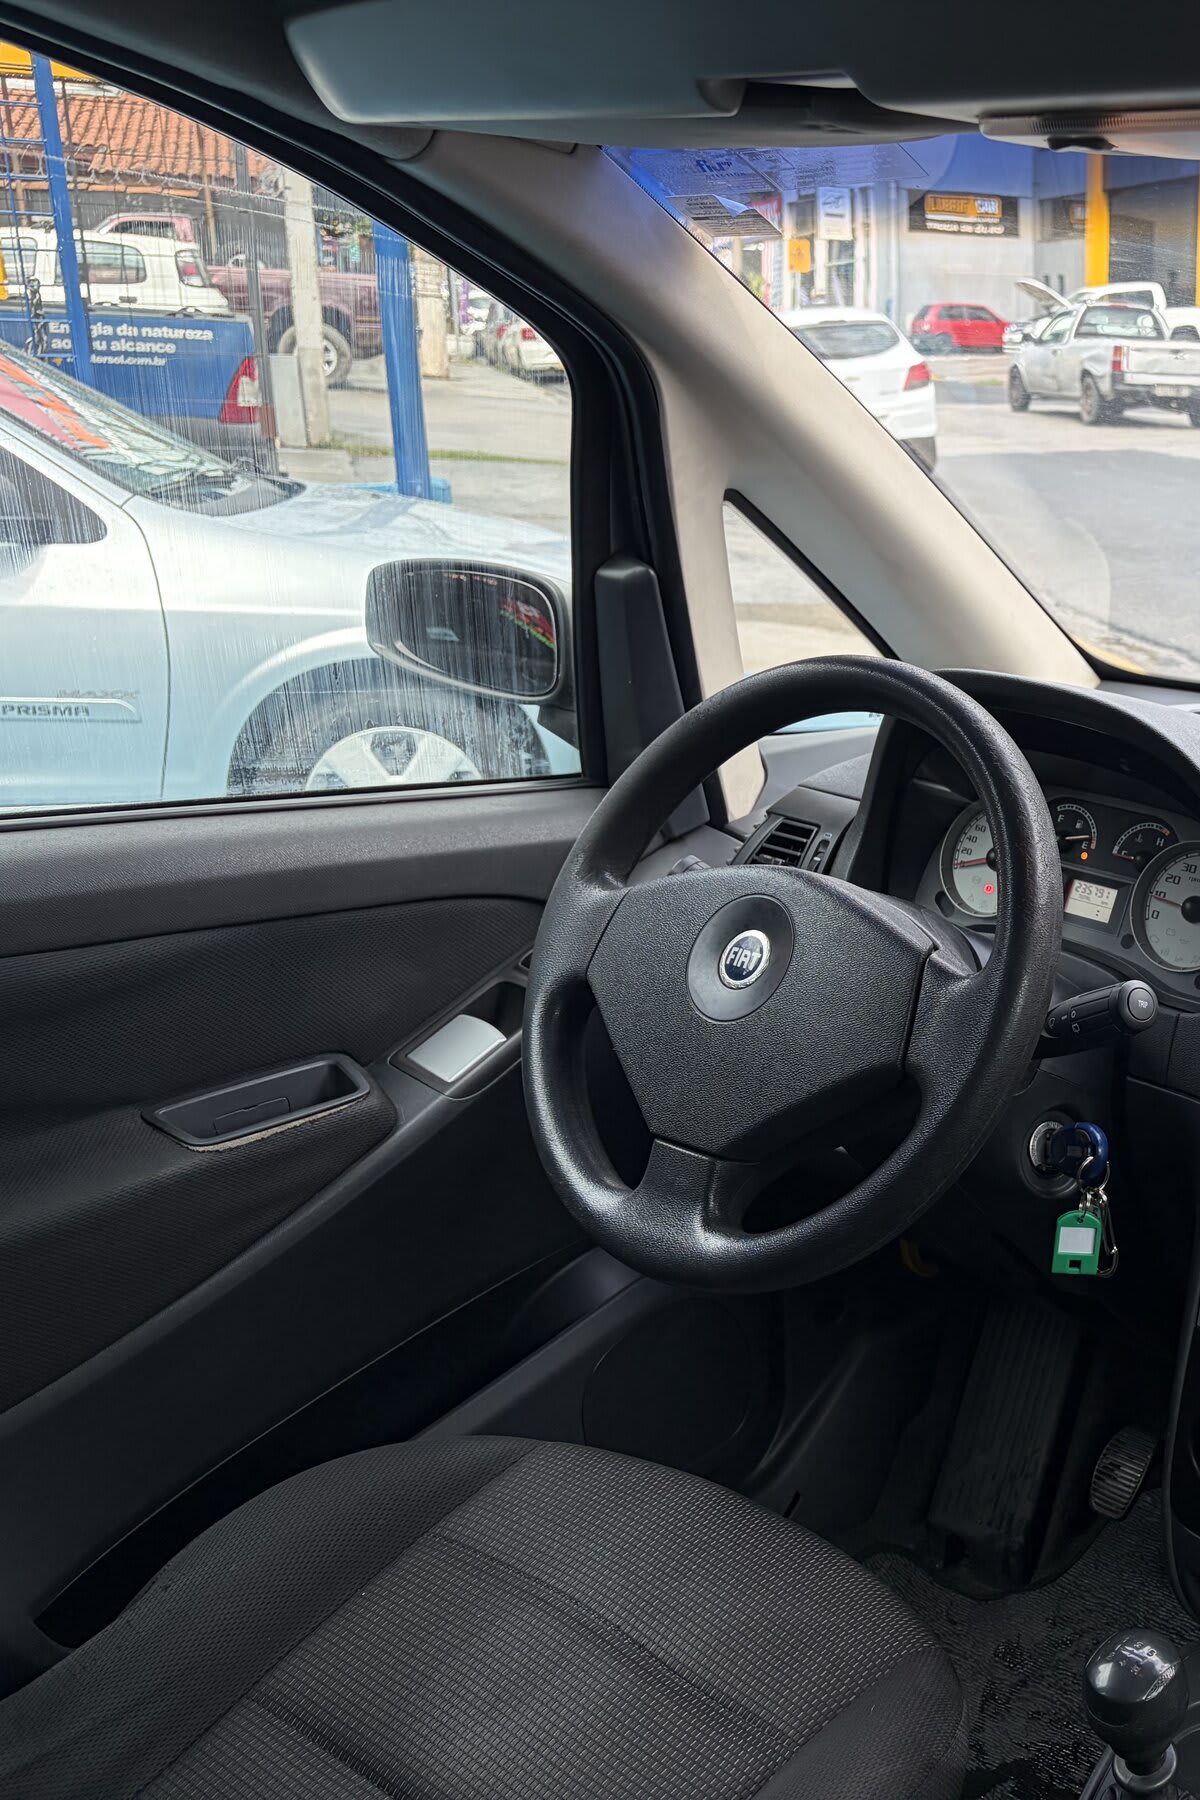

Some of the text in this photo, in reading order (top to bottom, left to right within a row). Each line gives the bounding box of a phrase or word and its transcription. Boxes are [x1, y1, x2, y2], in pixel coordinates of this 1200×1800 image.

[48, 322, 214, 341] Engia da natureza
[51, 338, 72, 350] ao
[110, 338, 177, 354] alcance
[1, 704, 91, 717] PRISMA
[1058, 814, 1064, 823] F
[1082, 842, 1089, 850] E
[1156, 838, 1164, 846] H
[960, 846, 973, 856] 20
[1181, 863, 1198, 874] 30
[1165, 873, 1181, 885] 20
[1151, 910, 1159, 919] 0
[726, 946, 762, 971] FIAT
[1137, 999, 1149, 1009] TRIP
